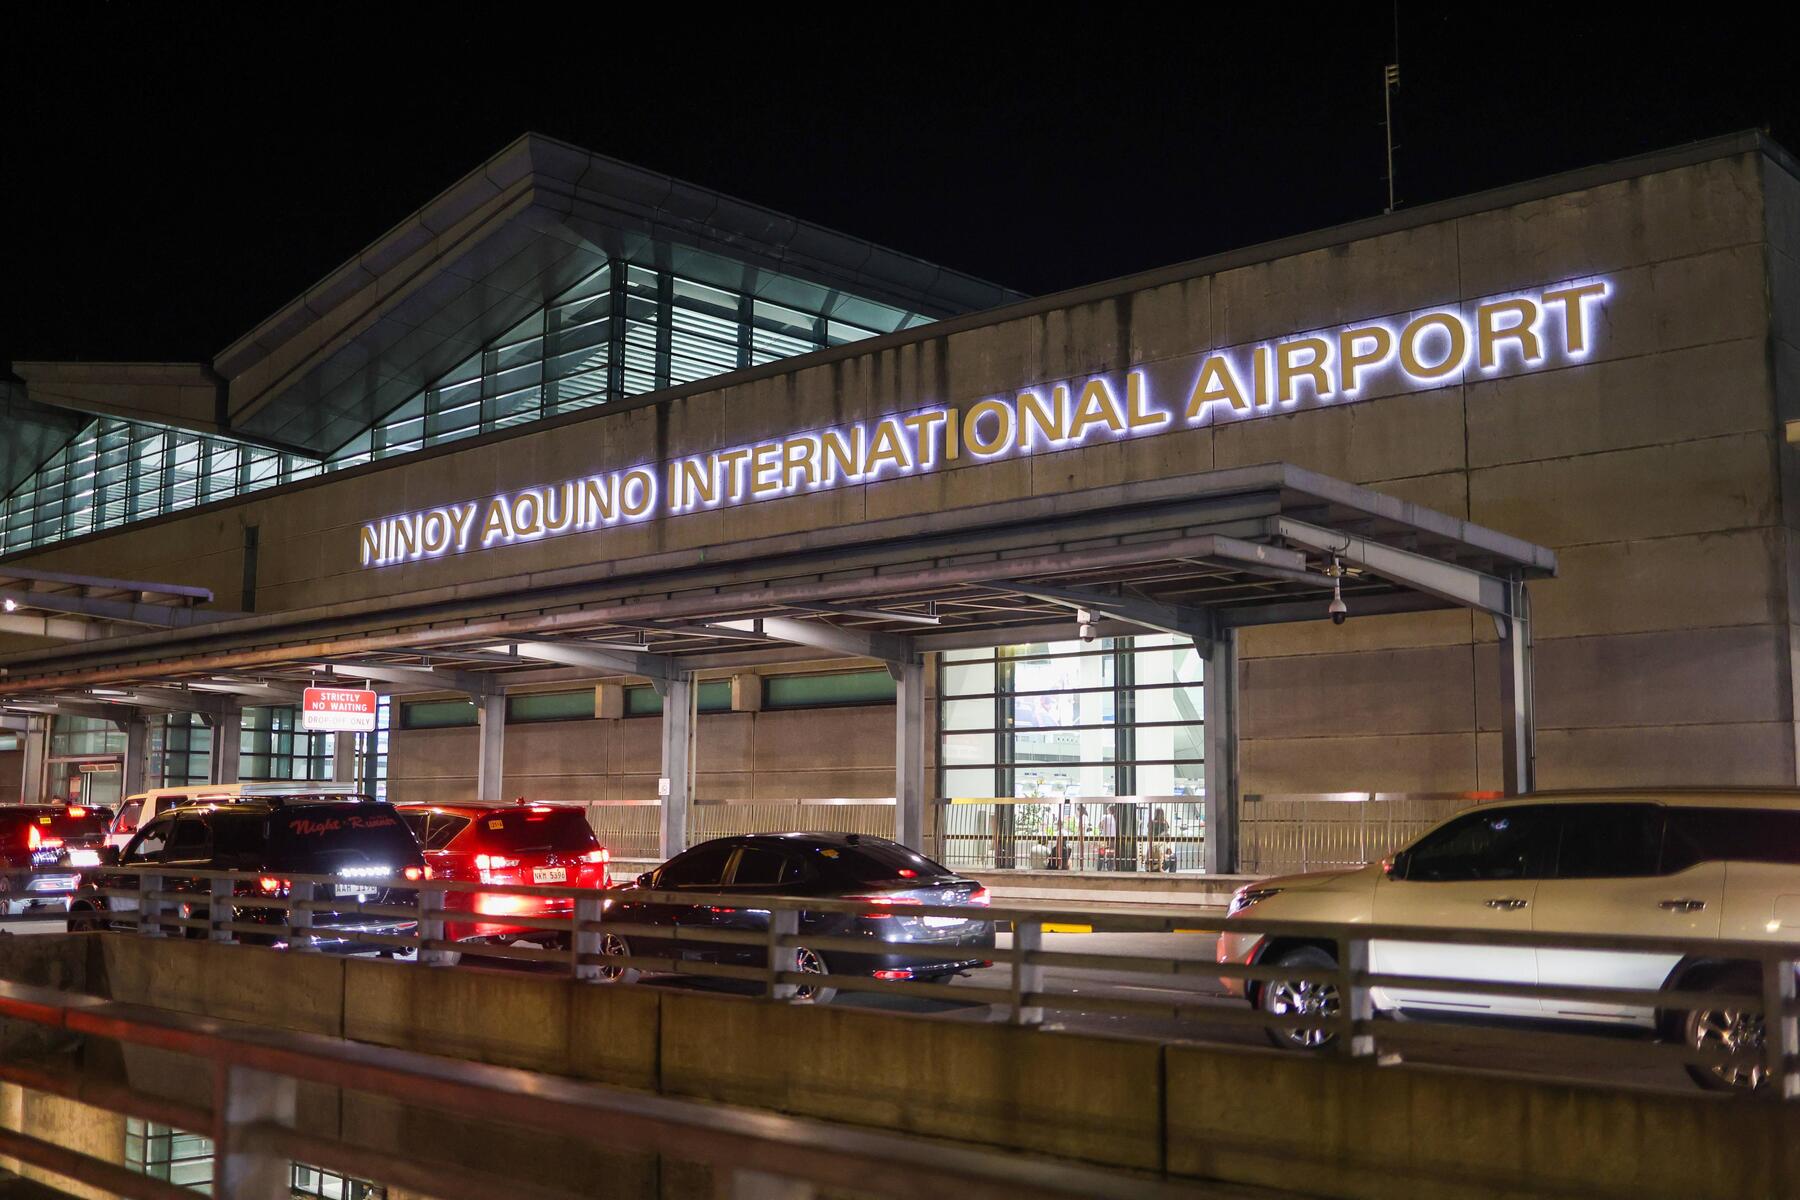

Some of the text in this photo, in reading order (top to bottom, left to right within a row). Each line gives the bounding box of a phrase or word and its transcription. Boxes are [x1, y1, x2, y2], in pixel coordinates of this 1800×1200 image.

[359, 282, 1608, 565] NINOY AQUINO INTERNATIONAL AIRPORT
[320, 692, 360, 702] STRICTLY
[312, 702, 368, 711] NO WAITING
[288, 819, 341, 836] Night
